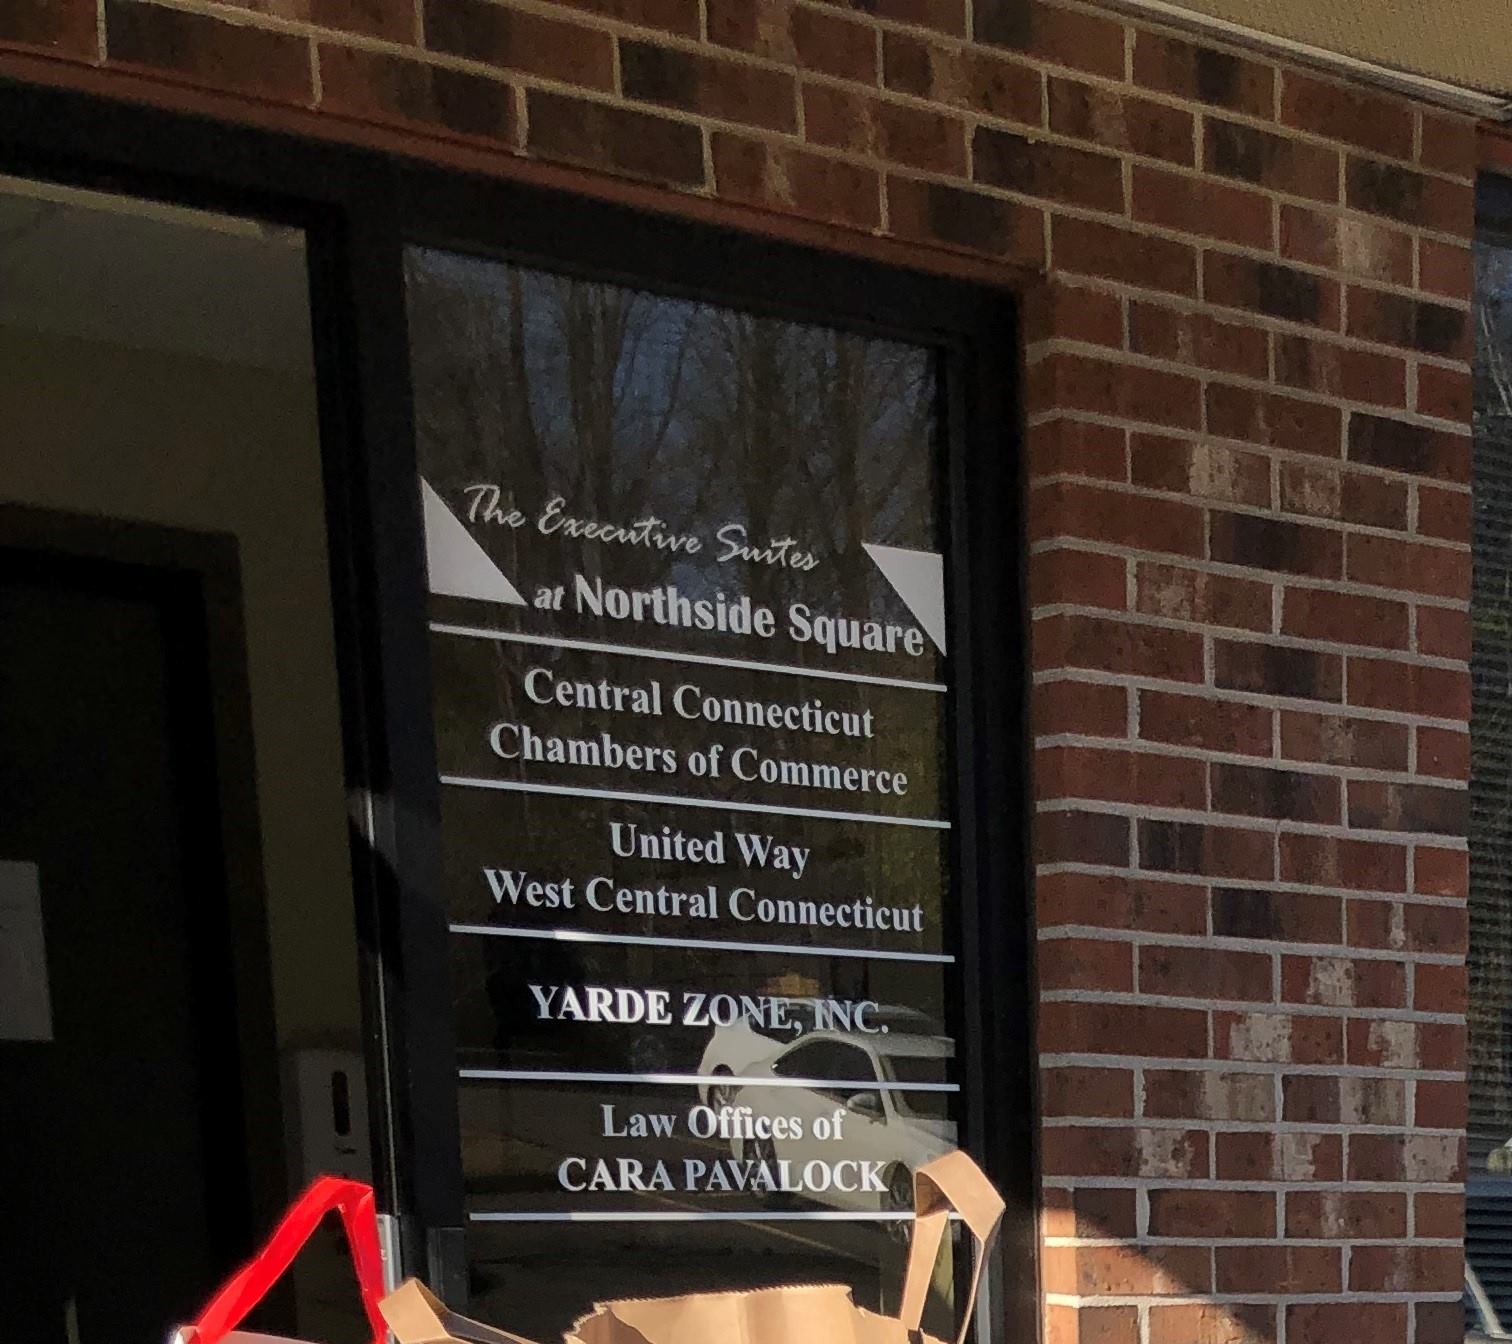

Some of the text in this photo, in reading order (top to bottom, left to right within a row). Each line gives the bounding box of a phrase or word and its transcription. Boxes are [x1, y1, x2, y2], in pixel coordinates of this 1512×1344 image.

[464, 484, 819, 572] The Executive Suites
[534, 573, 925, 656] at Northside Square
[524, 667, 874, 739] Central Connecticut
[490, 723, 907, 795] Chambers of Commerce
[609, 822, 810, 880] United Way
[483, 868, 924, 932] West Central Connecticut
[527, 984, 889, 1036] YARDE ZONE, INC.
[601, 1103, 846, 1140] Law Offices of
[557, 1157, 890, 1192] CARA PAVALOCK
